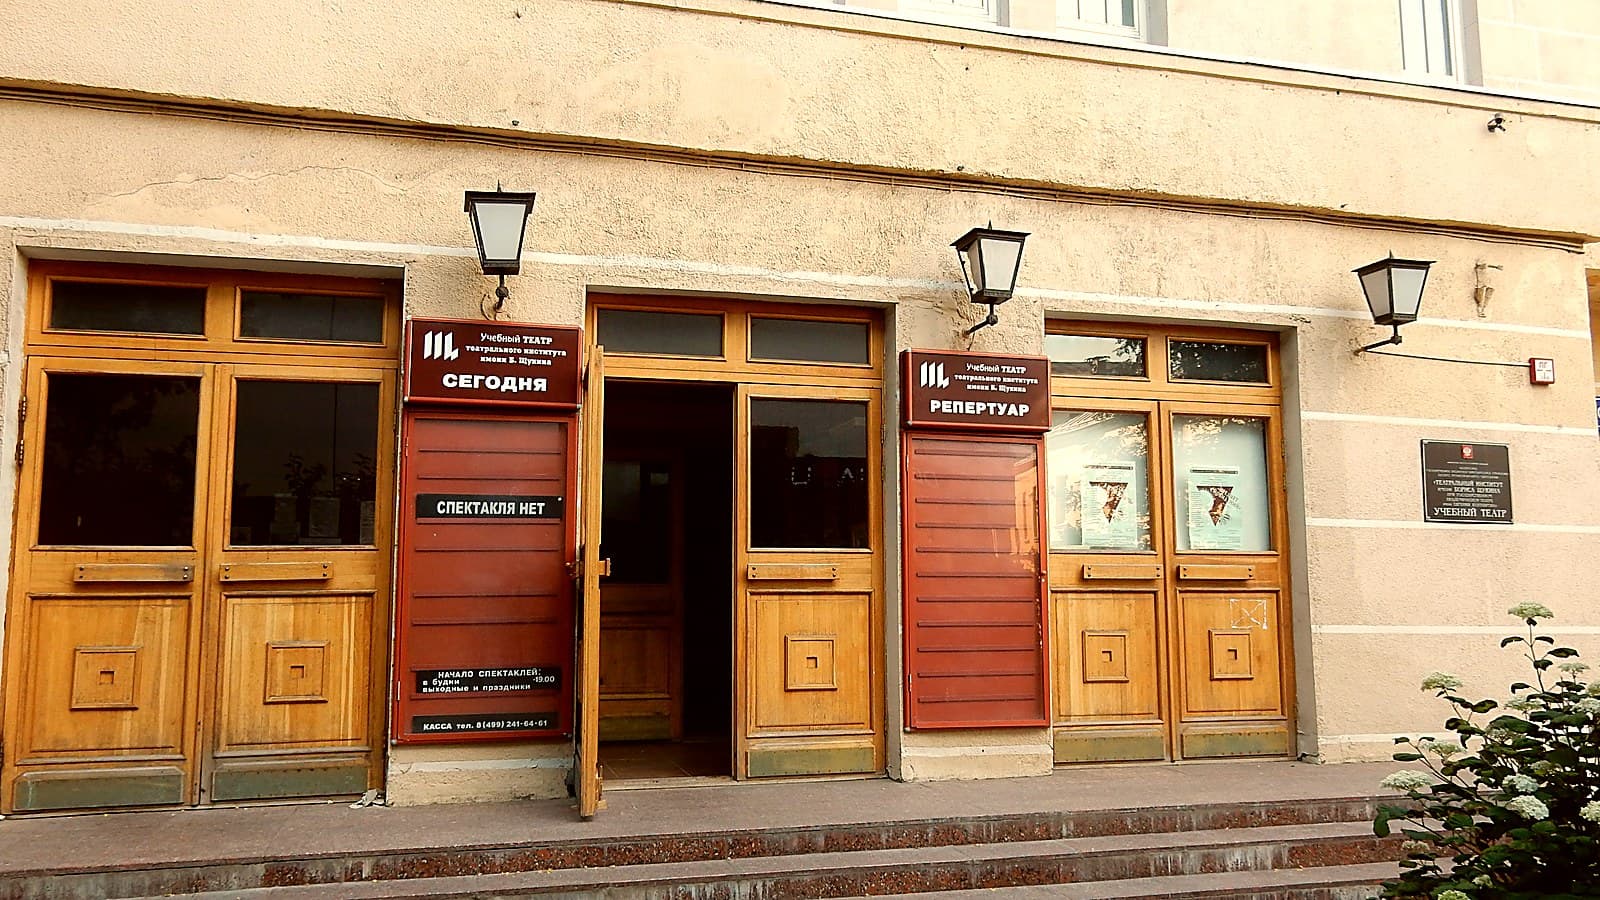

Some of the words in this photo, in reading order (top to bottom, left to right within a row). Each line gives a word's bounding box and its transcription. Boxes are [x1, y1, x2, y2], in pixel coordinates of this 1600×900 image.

[480, 332, 521, 344] Учебный
[522, 336, 553, 345] ТЕАТР
[465, 344, 522, 354] театрального
[524, 348, 567, 358] института
[480, 356, 508, 364] имени
[518, 357, 552, 366] Щукина
[966, 362, 1000, 373] Учебный
[1000, 366, 1026, 374] ТЕАТР
[442, 373, 548, 392] СЕГОДНЯ
[930, 400, 1030, 416] РЕПЕРТУАР
[436, 500, 516, 514] СПЕКТАКЛЯ
[519, 502, 546, 515] НЕТ
[1434, 508, 1476, 517] УЧЕБНЫЙ
[1480, 509, 1507, 518] ТЕАТР
[438, 670, 474, 678] НАЧАЛО
[478, 668, 542, 678] СПЕКТАКЛЕЙ:
[432, 678, 460, 687] будни
[482, 684, 531, 692] праздники
[506, 720, 548, 728] 241-64-61
